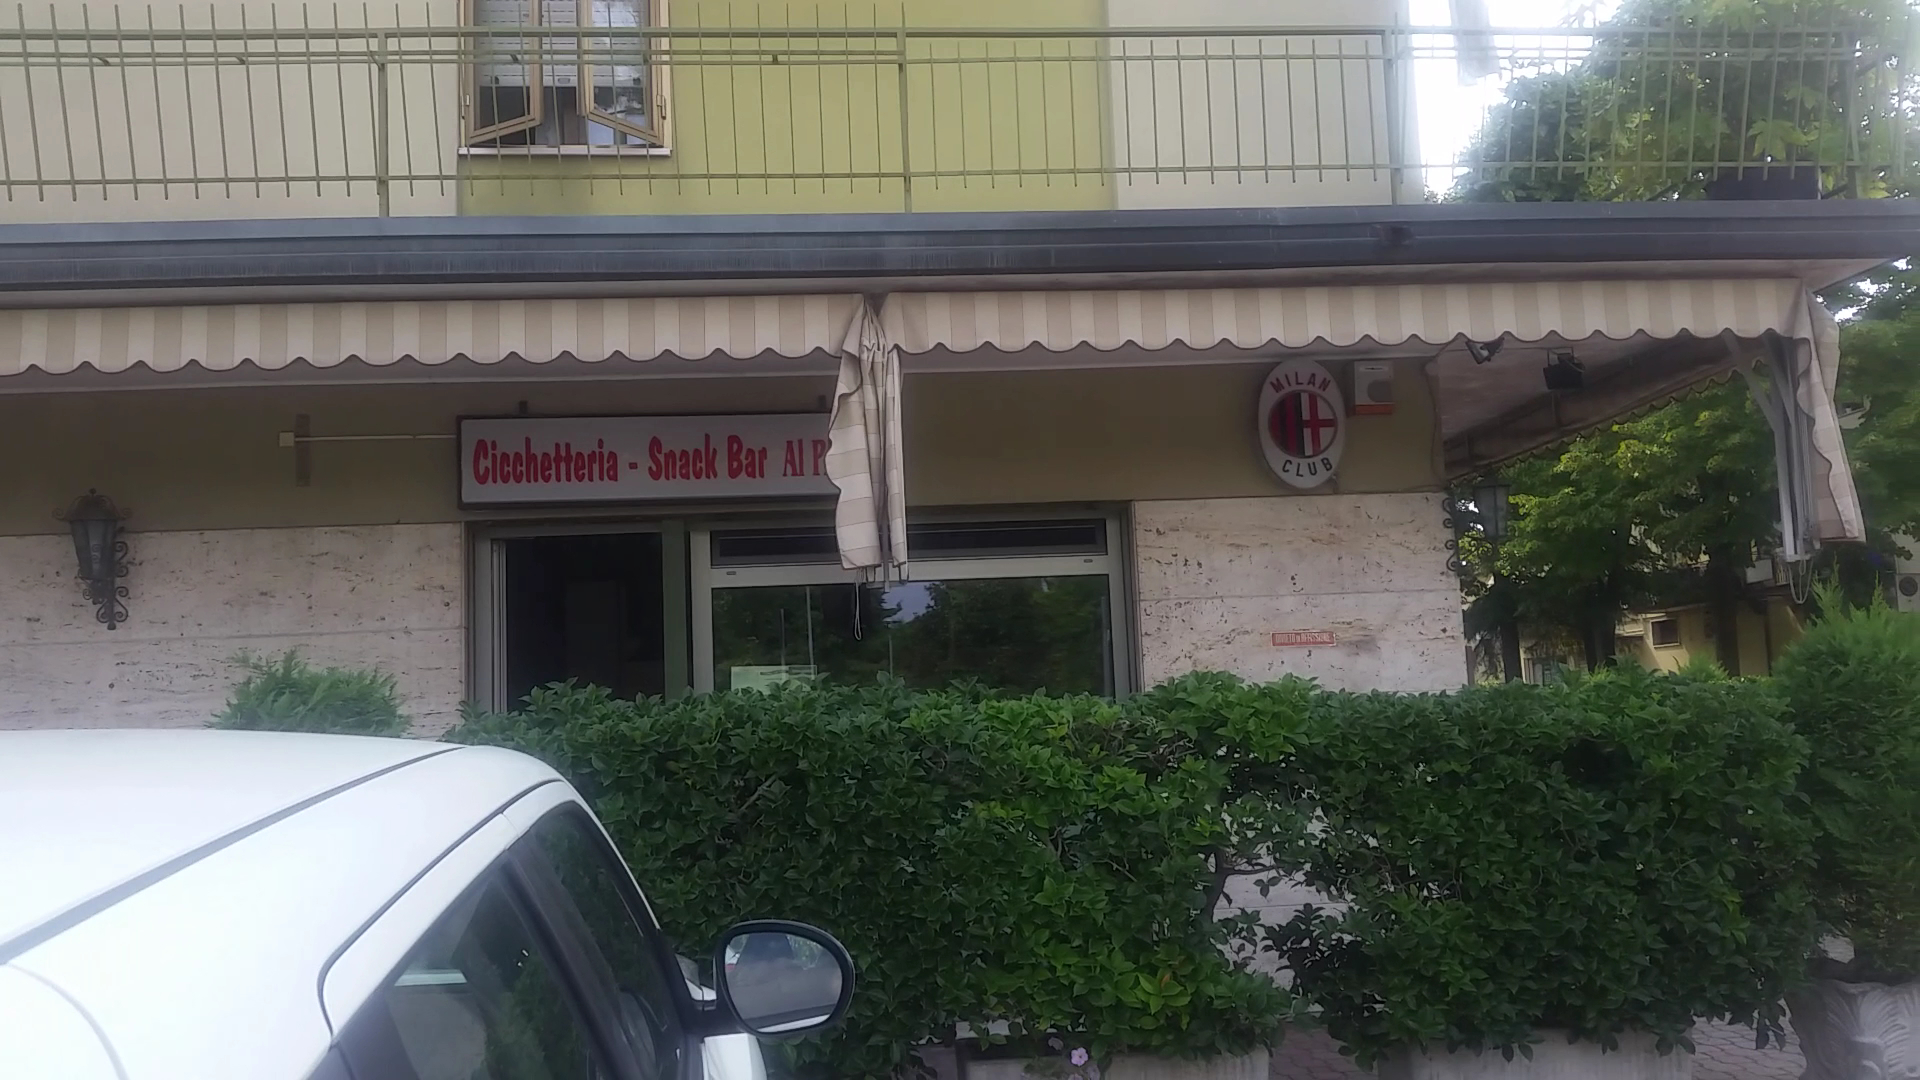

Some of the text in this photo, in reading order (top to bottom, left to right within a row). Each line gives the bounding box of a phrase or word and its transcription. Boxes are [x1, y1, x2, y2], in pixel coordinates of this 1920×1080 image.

[1270, 371, 1331, 393] MILAN
[473, 436, 618, 484] Cicchetteria
[648, 433, 718, 481] Snack
[727, 435, 768, 479] Bar
[782, 438, 805, 477] Al
[811, 439, 829, 476] P
[1282, 457, 1333, 477] CLUB
